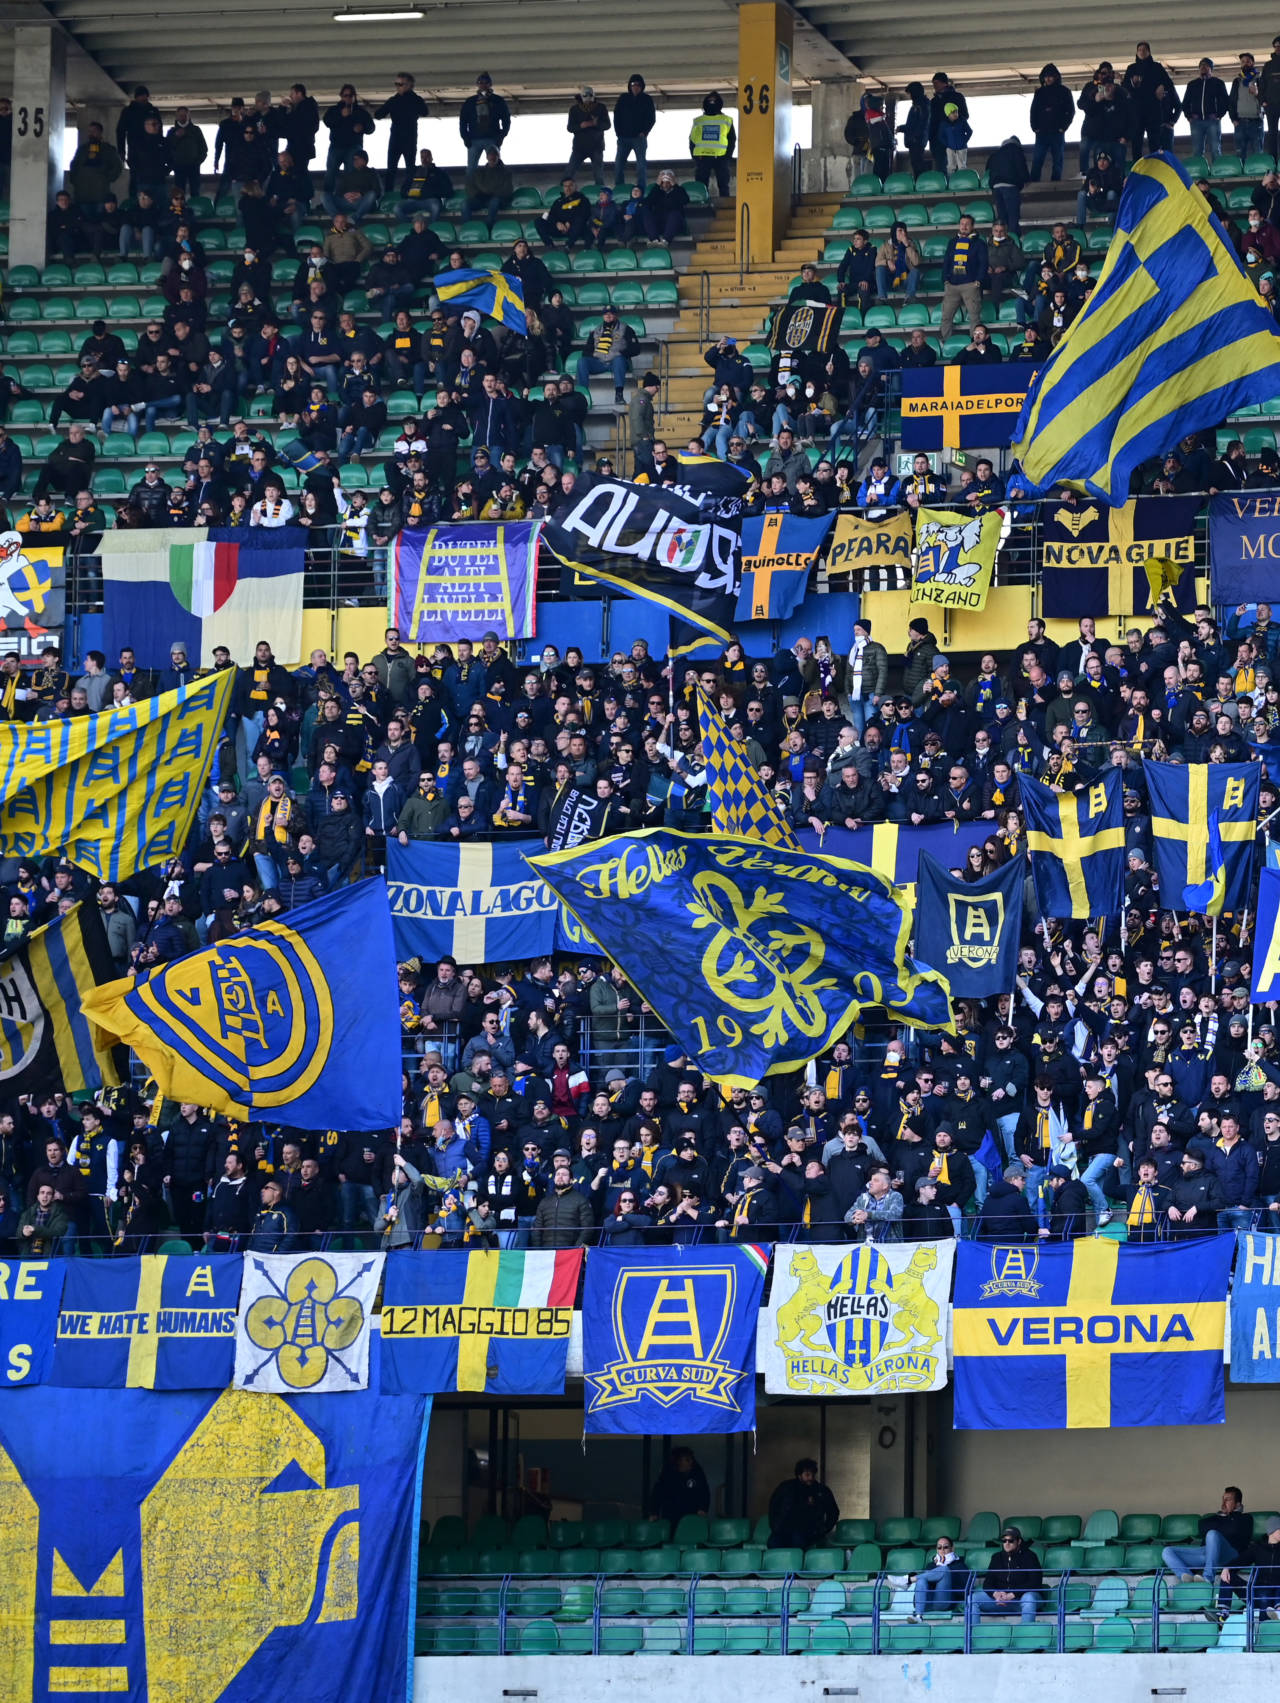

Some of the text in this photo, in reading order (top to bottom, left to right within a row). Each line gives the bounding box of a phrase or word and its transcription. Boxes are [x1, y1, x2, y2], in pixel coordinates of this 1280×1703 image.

[743, 84, 770, 115] 36
[17, 106, 45, 138] 35
[1044, 539, 1191, 566] NOVAGLIE
[911, 587, 981, 607] INZANO
[575, 844, 688, 900] Hellas
[952, 945, 999, 958] VERONA
[826, 1293, 890, 1321] HELLAS
[59, 1311, 236, 1334] WE HATE HUMANS
[382, 1306, 571, 1337] 12 MAGGIO 85
[986, 1313, 1194, 1346] VERONA
[620, 1365, 715, 1384] CURVA SUD
[790, 1357, 932, 1385] HELLAS VERONA
